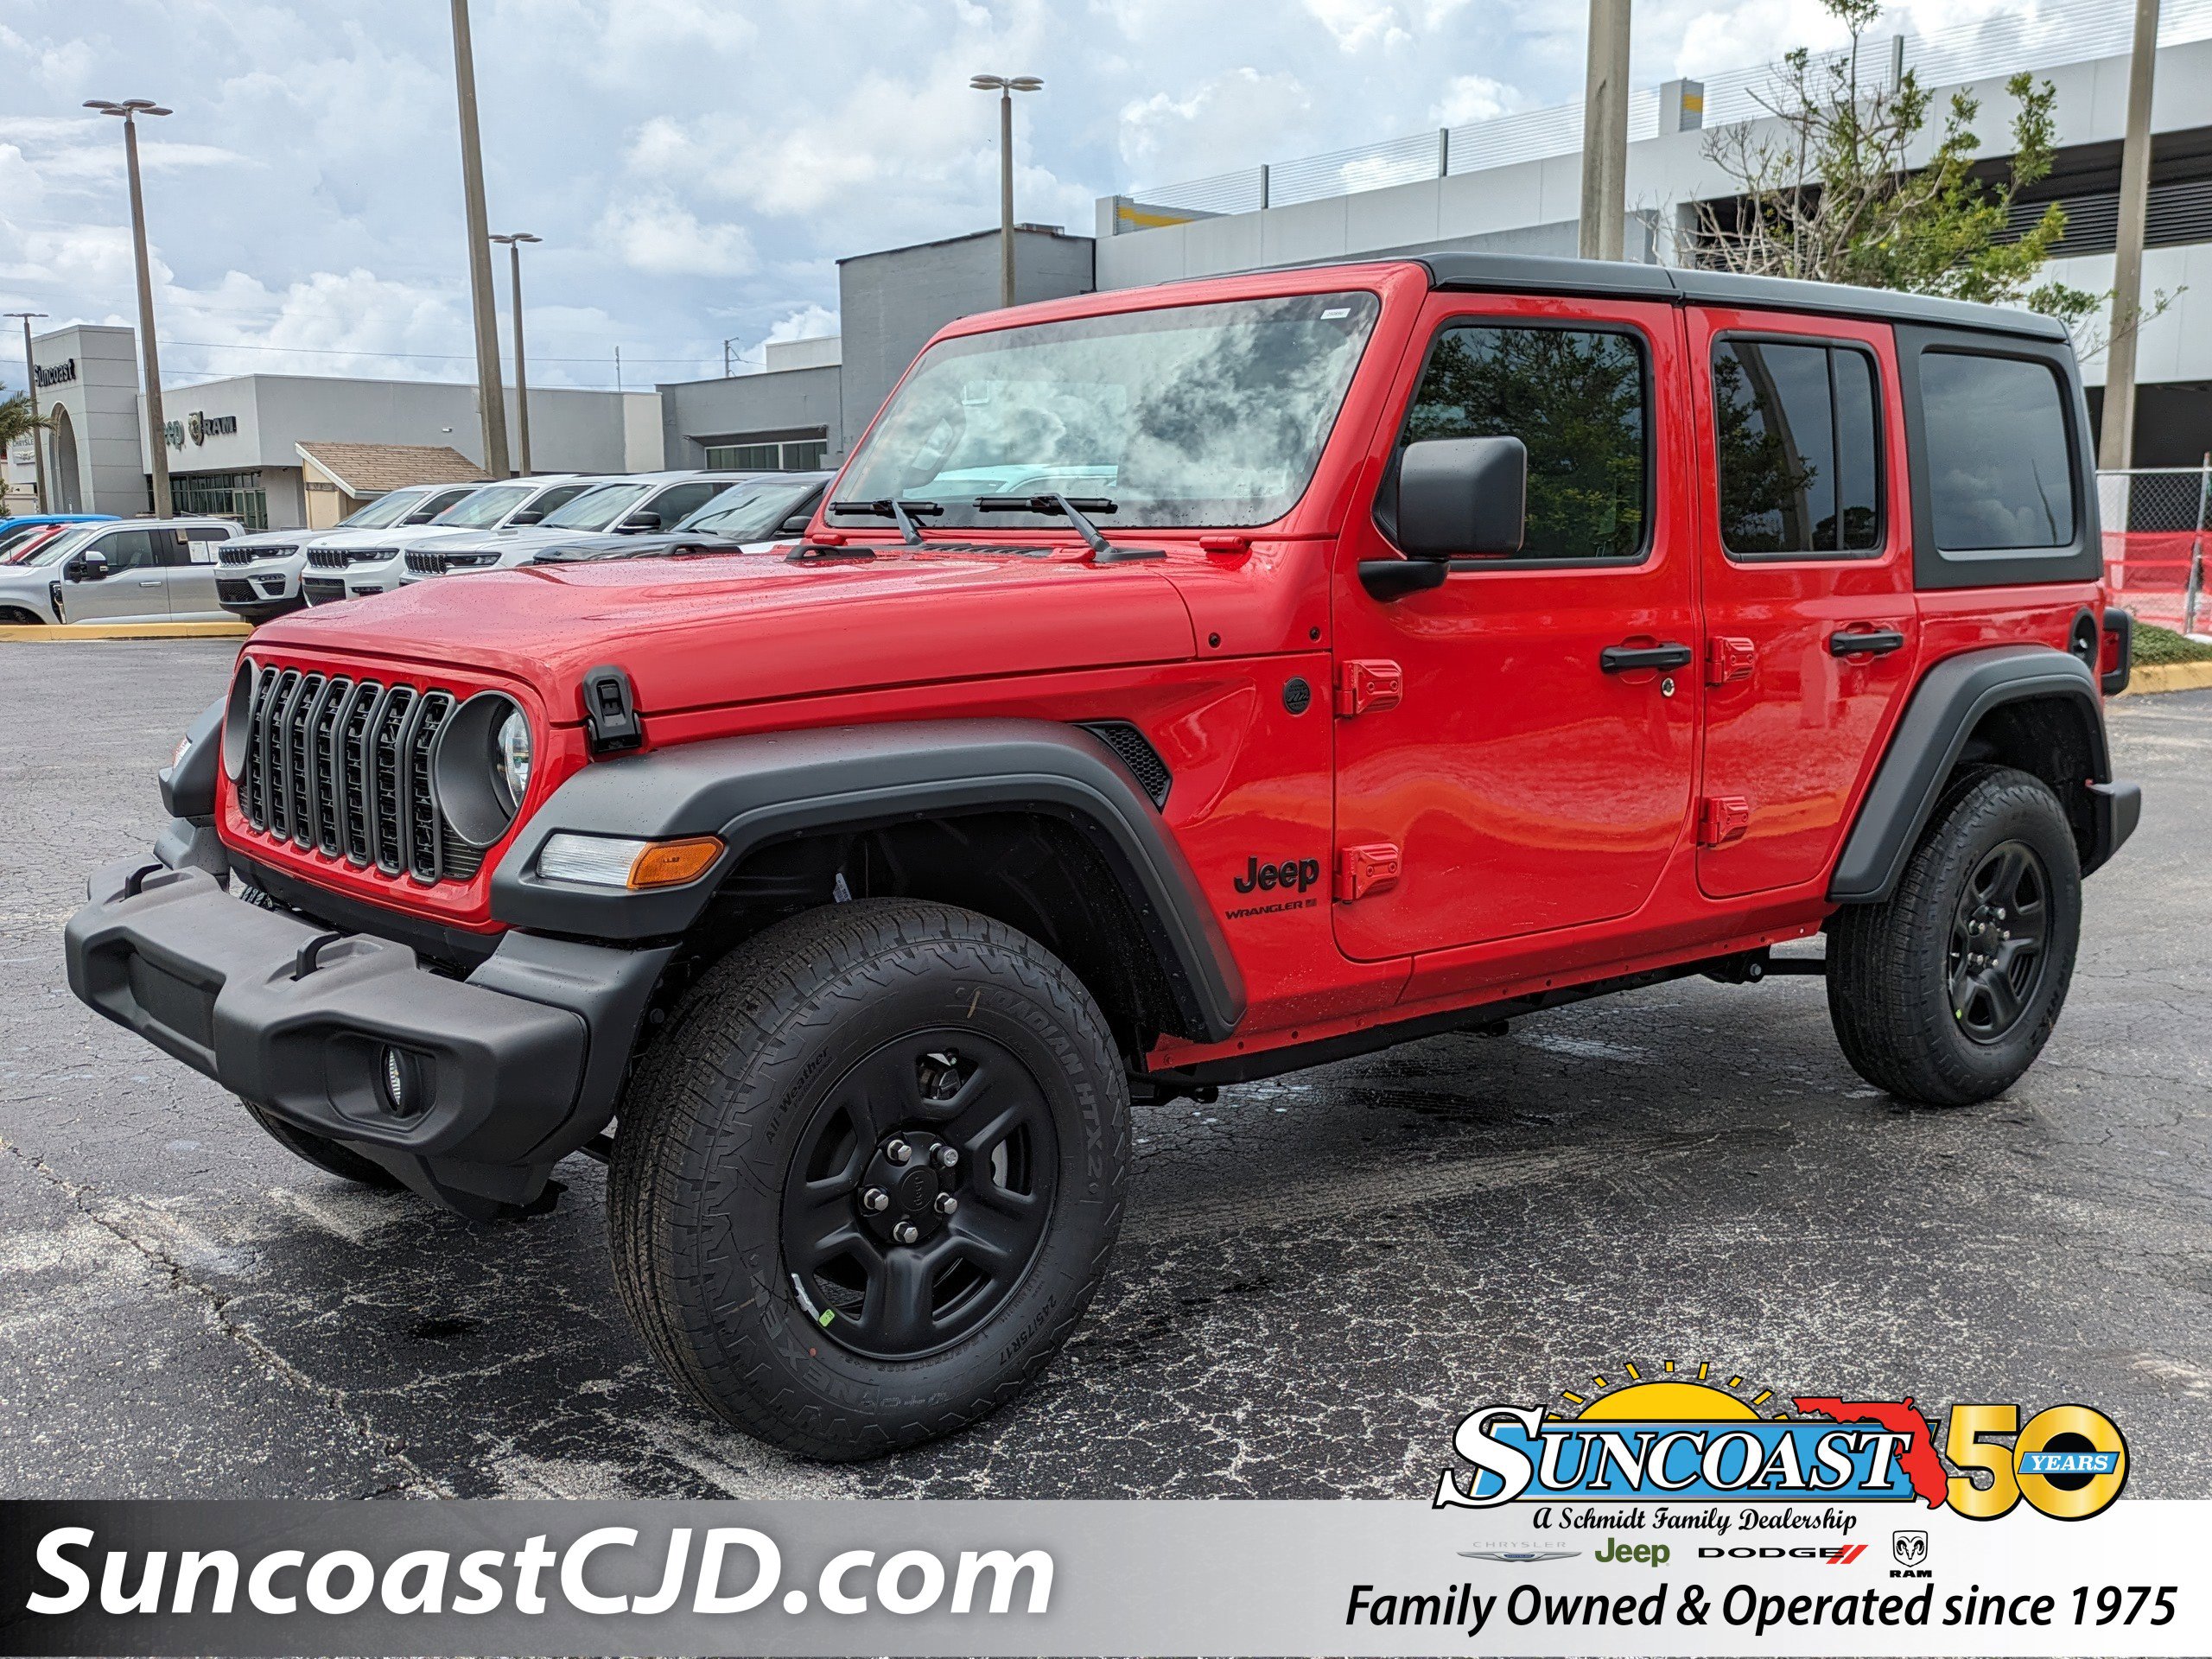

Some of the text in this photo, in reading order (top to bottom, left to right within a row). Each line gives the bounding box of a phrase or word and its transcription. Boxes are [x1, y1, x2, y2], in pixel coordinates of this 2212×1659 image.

[34, 359, 76, 387] Suncoast
[202, 416, 236, 435] RAM
[12, 438, 35, 448] CHRYSLE
[1234, 855, 1319, 893] Jeep
[1225, 900, 1303, 919] WRANGLER
[766, 1046, 830, 1146] All-Weather
[912, 1176, 925, 1205] Jeep
[749, 1270, 855, 1405] NEXEN
[998, 1294, 1057, 1366] 245/75R17
